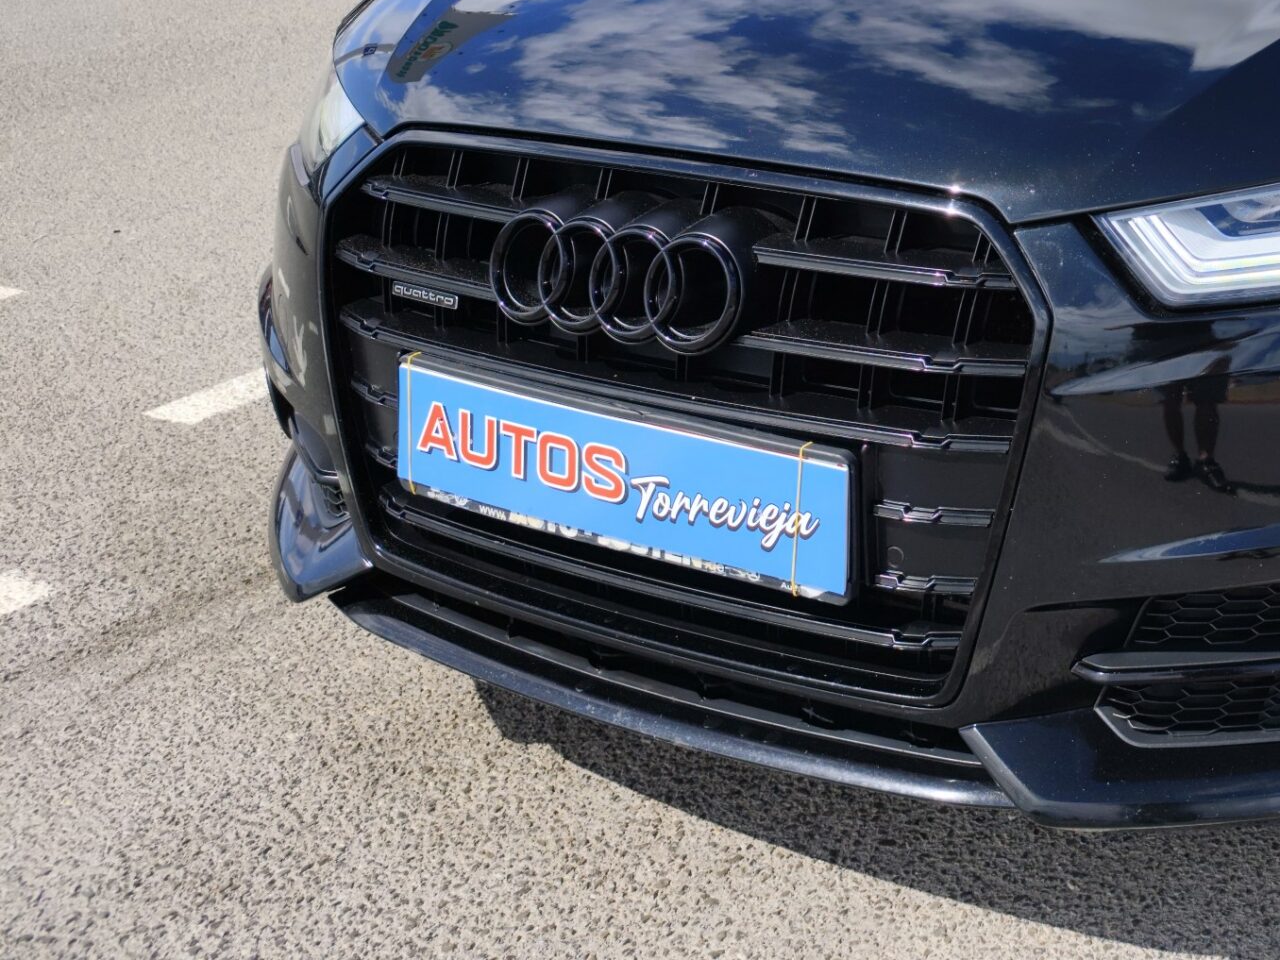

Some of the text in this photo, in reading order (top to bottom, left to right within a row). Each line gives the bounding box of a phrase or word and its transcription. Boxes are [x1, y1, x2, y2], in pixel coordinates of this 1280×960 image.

[394, 284, 454, 305] quattro
[416, 400, 628, 504] AUTOS
[630, 475, 820, 552] Torrevieja
